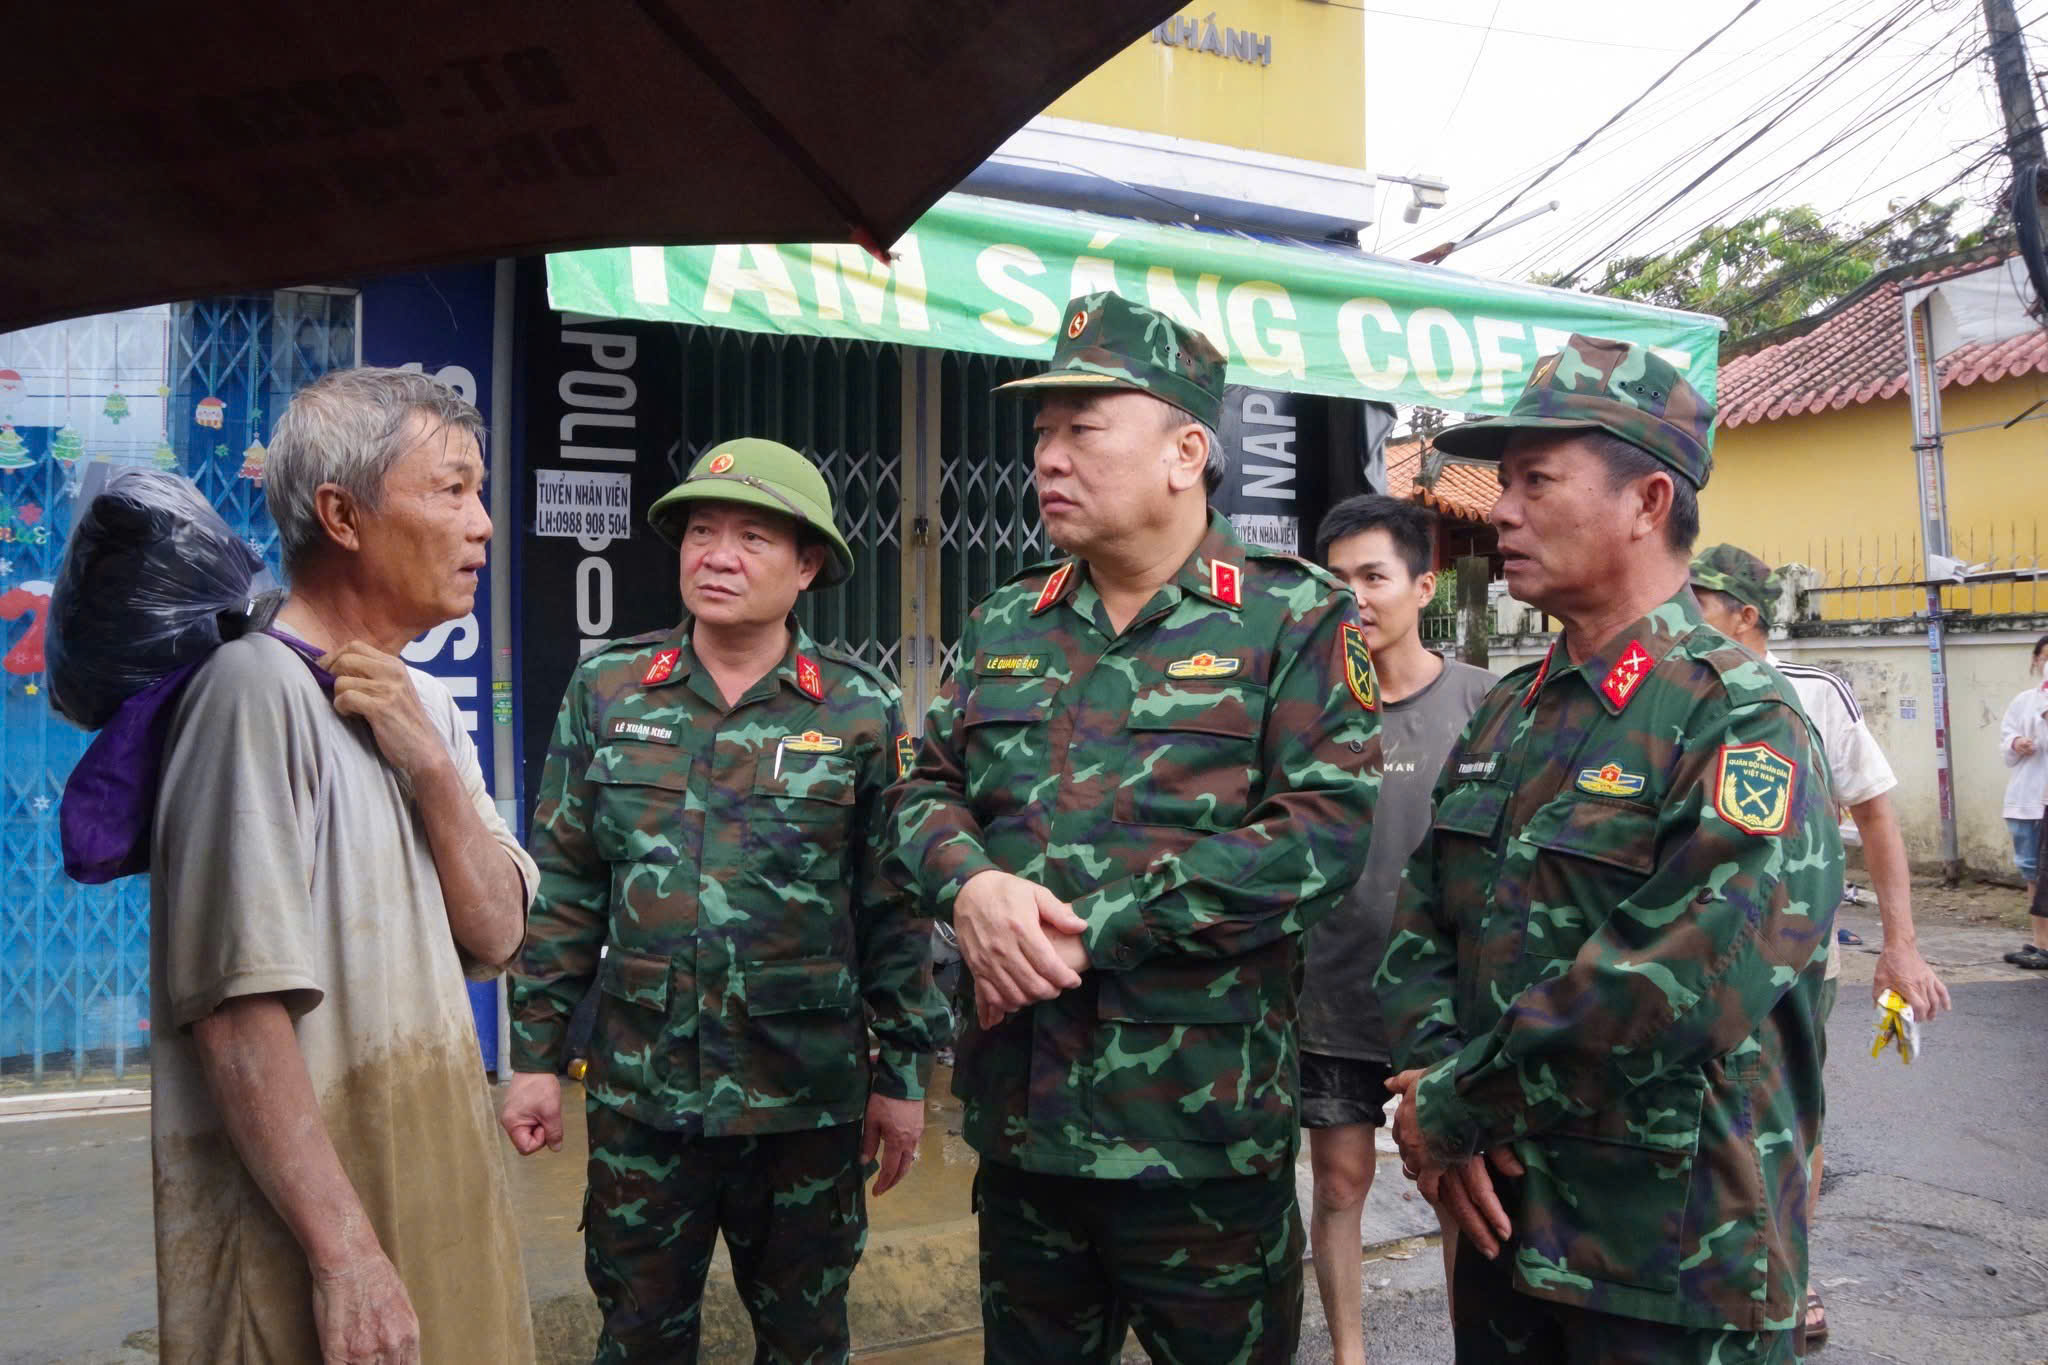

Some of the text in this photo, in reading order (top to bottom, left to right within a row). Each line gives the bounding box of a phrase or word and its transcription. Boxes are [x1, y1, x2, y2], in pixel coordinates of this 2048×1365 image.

[1242, 393, 1297, 500] NAP
[539, 472, 628, 508] TUYỂN NHÂN VIÊN
[539, 510, 628, 536] LH:0988 908 504
[614, 721, 626, 733] LÊ
[626, 723, 650, 735] XUÂN
